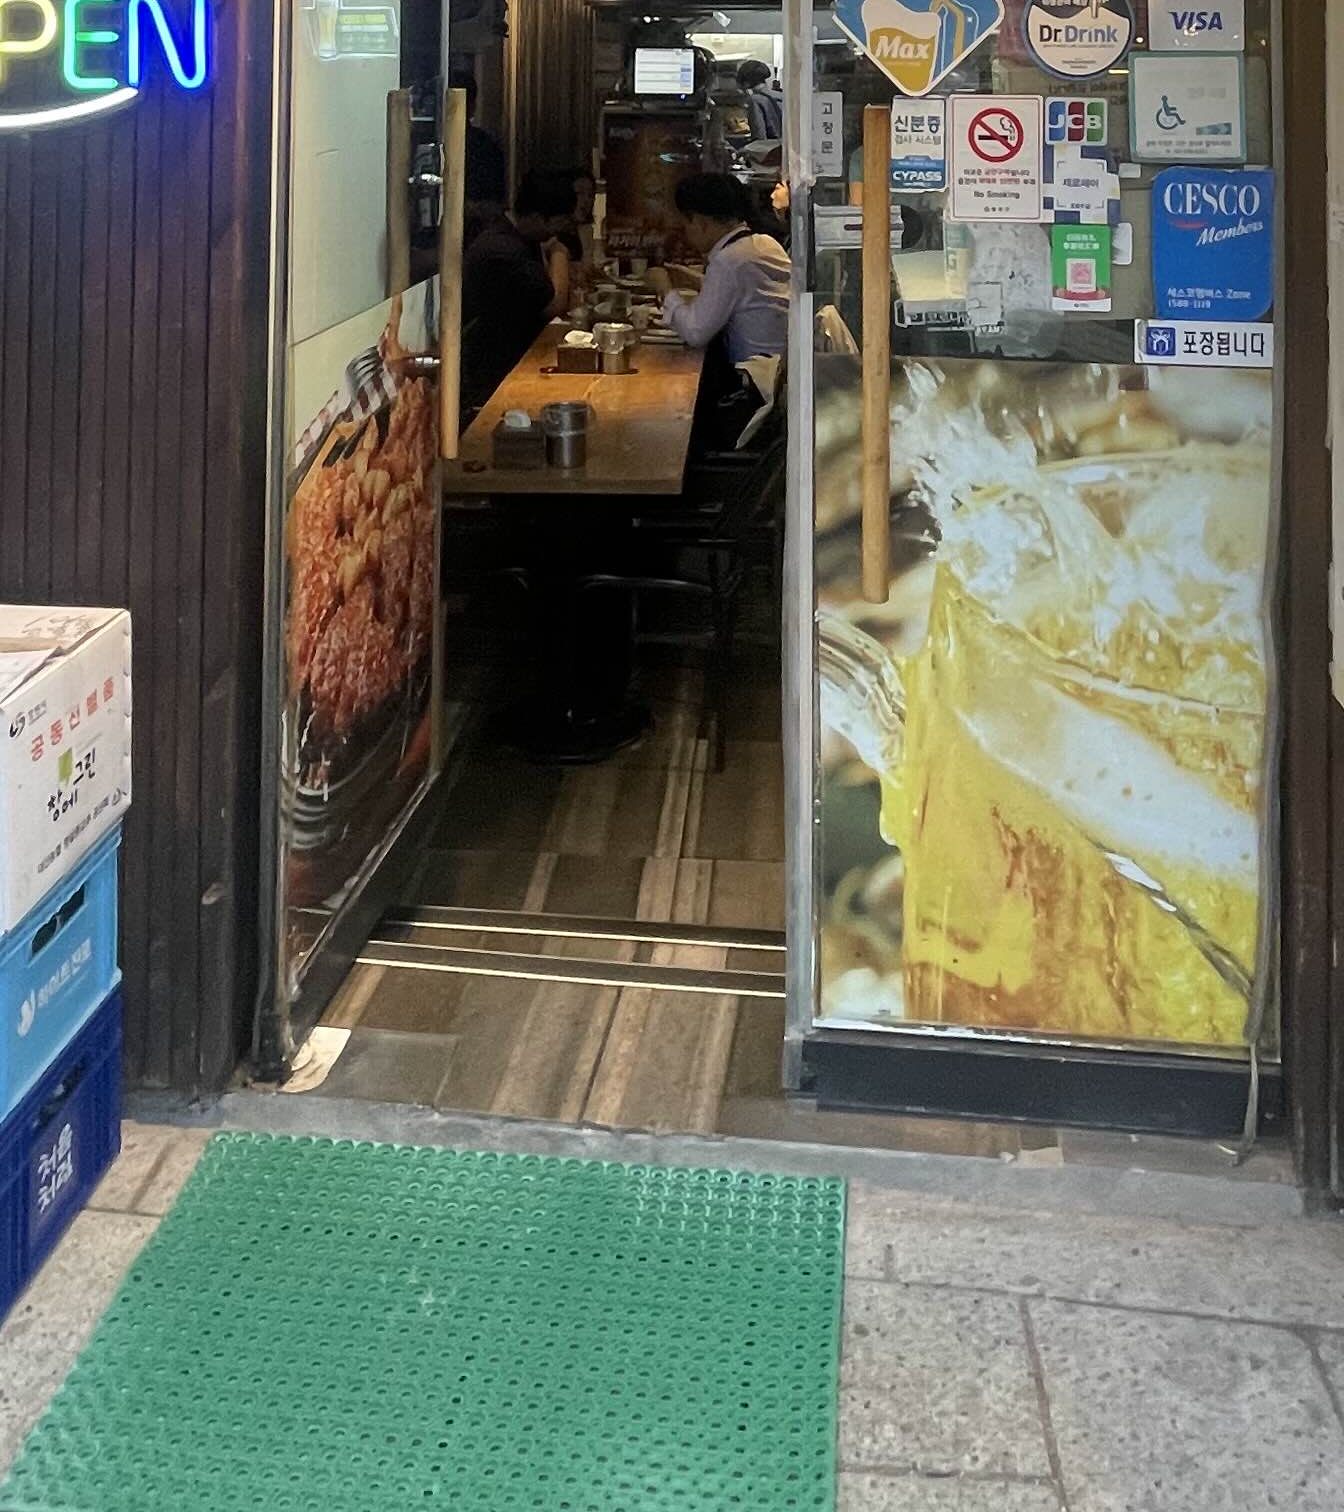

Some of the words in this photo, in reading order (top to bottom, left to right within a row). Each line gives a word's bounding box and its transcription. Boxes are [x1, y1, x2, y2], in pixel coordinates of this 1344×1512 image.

[1168, 11, 1224, 32] VISA
[875, 36, 929, 59] Max
[821, 102, 833, 154] 고정문
[894, 115, 941, 134] 신분증
[1048, 113, 1102, 129] JCB
[892, 170, 943, 182] CYPASS
[987, 190, 1021, 200] Smoking
[1163, 182, 1261, 216] CESCO
[1196, 217, 1264, 247] Members
[1183, 330, 1265, 358] 포장됩니다
